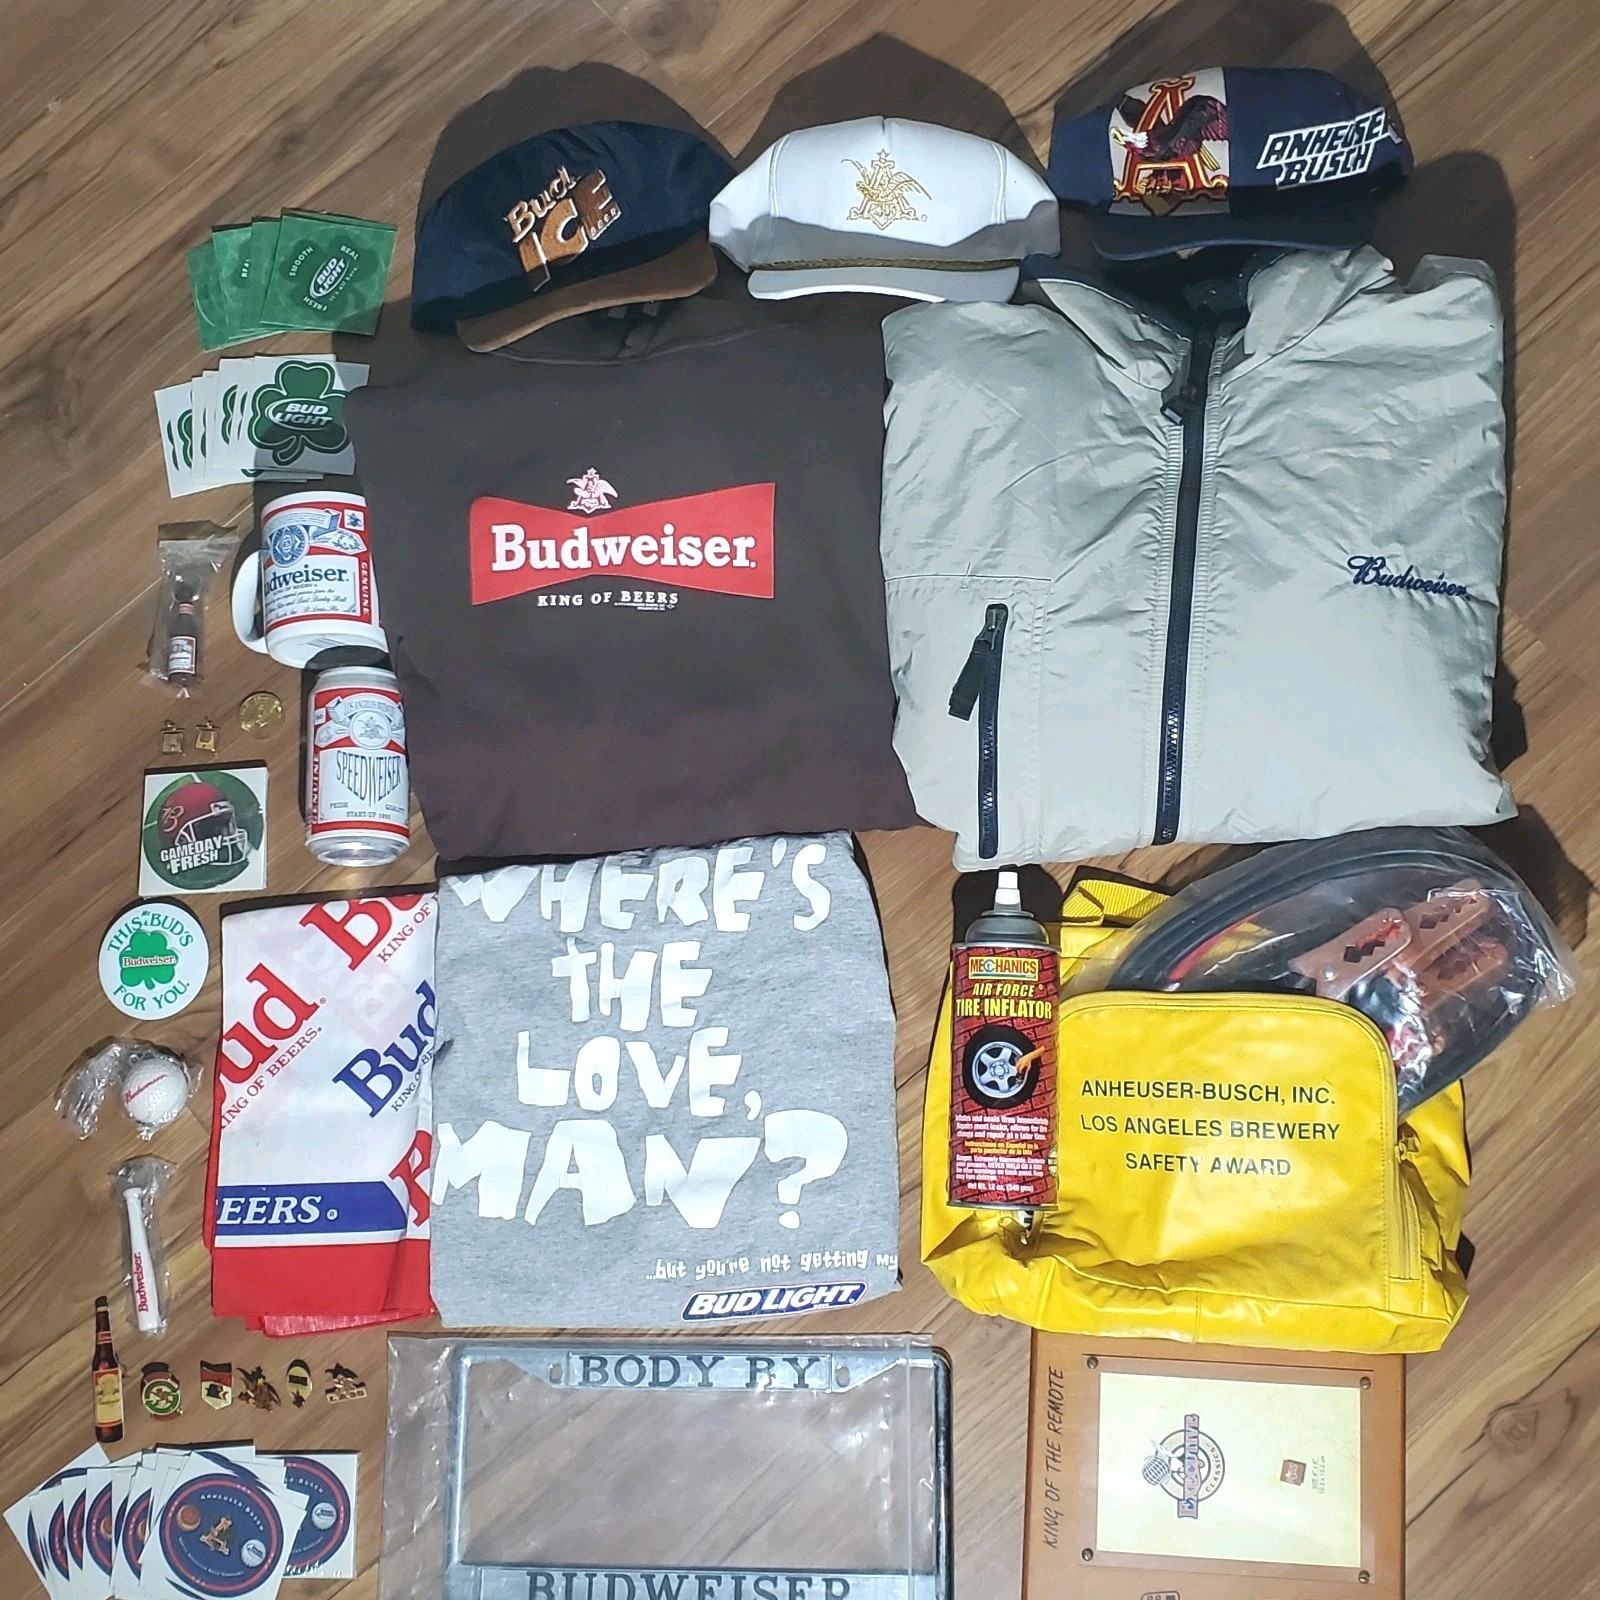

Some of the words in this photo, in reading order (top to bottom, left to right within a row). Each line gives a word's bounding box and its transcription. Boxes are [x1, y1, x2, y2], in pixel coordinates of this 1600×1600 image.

[1275, 142, 1375, 190] BUSCH
[503, 165, 580, 243] Bud
[289, 246, 314, 277] SMOOTH
[340, 245, 359, 261] REAL
[316, 257, 337, 286] BUD
[319, 258, 347, 294] LIGHT
[303, 296, 328, 312] FRESH
[274, 412, 333, 426] LIGHT
[284, 402, 328, 416] BUD
[264, 563, 349, 597] udweiser
[361, 562, 370, 616] GENUINE
[538, 594, 583, 607] KING
[591, 591, 613, 605] OF
[620, 591, 679, 604] BEERS
[336, 750, 402, 806] SPEEDWEISER
[160, 835, 225, 862] GAMEDAY
[170, 849, 219, 874] FRESH
[445, 837, 831, 933] WHERE'S
[107, 916, 143, 951] THIS
[150, 913, 194, 947] BUD'S
[377, 925, 415, 963] KING
[413, 903, 432, 924] OF
[123, 955, 175, 967] Budweiser
[970, 959, 1037, 974] MECHANICS
[113, 985, 146, 1011] FOR
[152, 980, 191, 1009] YOU.
[972, 983, 993, 996] AIR
[995, 983, 1035, 997] FORCE
[219, 962, 320, 1084] ud
[956, 998, 980, 1017] TIRE
[984, 998, 1052, 1020] INFLATOR
[517, 1026, 762, 1120] LOVE,
[221, 1096, 249, 1129] ING
[246, 1076, 265, 1097] OF
[391, 1082, 416, 1112] KING
[1081, 1080, 1286, 1106] ANHEUSER-BUSCH,
[1292, 1086, 1336, 1105] INC.
[1080, 1114, 1118, 1133] LOS
[1124, 1117, 1223, 1137] ANGELES
[1230, 1120, 1341, 1140] BREWERY
[431, 1108, 849, 1230] MAN?
[1125, 1153, 1202, 1173] SAFETY
[1210, 1156, 1291, 1176] AWARD
[216, 1195, 322, 1225] EERS
[695, 1256, 750, 1280] you're
[760, 1254, 791, 1273] not
[800, 1249, 869, 1271] getting
[688, 1291, 760, 1316] BUD
[578, 1354, 726, 1389] BODY
[745, 1355, 821, 1389] BY
[1047, 1365, 1065, 1436] REMOTE
[1046, 1442, 1063, 1474] THE
[1205, 1446, 1222, 1493] CLASSICS
[1047, 1482, 1063, 1502] OF
[1043, 1505, 1063, 1549] KING
[527, 1571, 851, 1600] BUDWEISER
